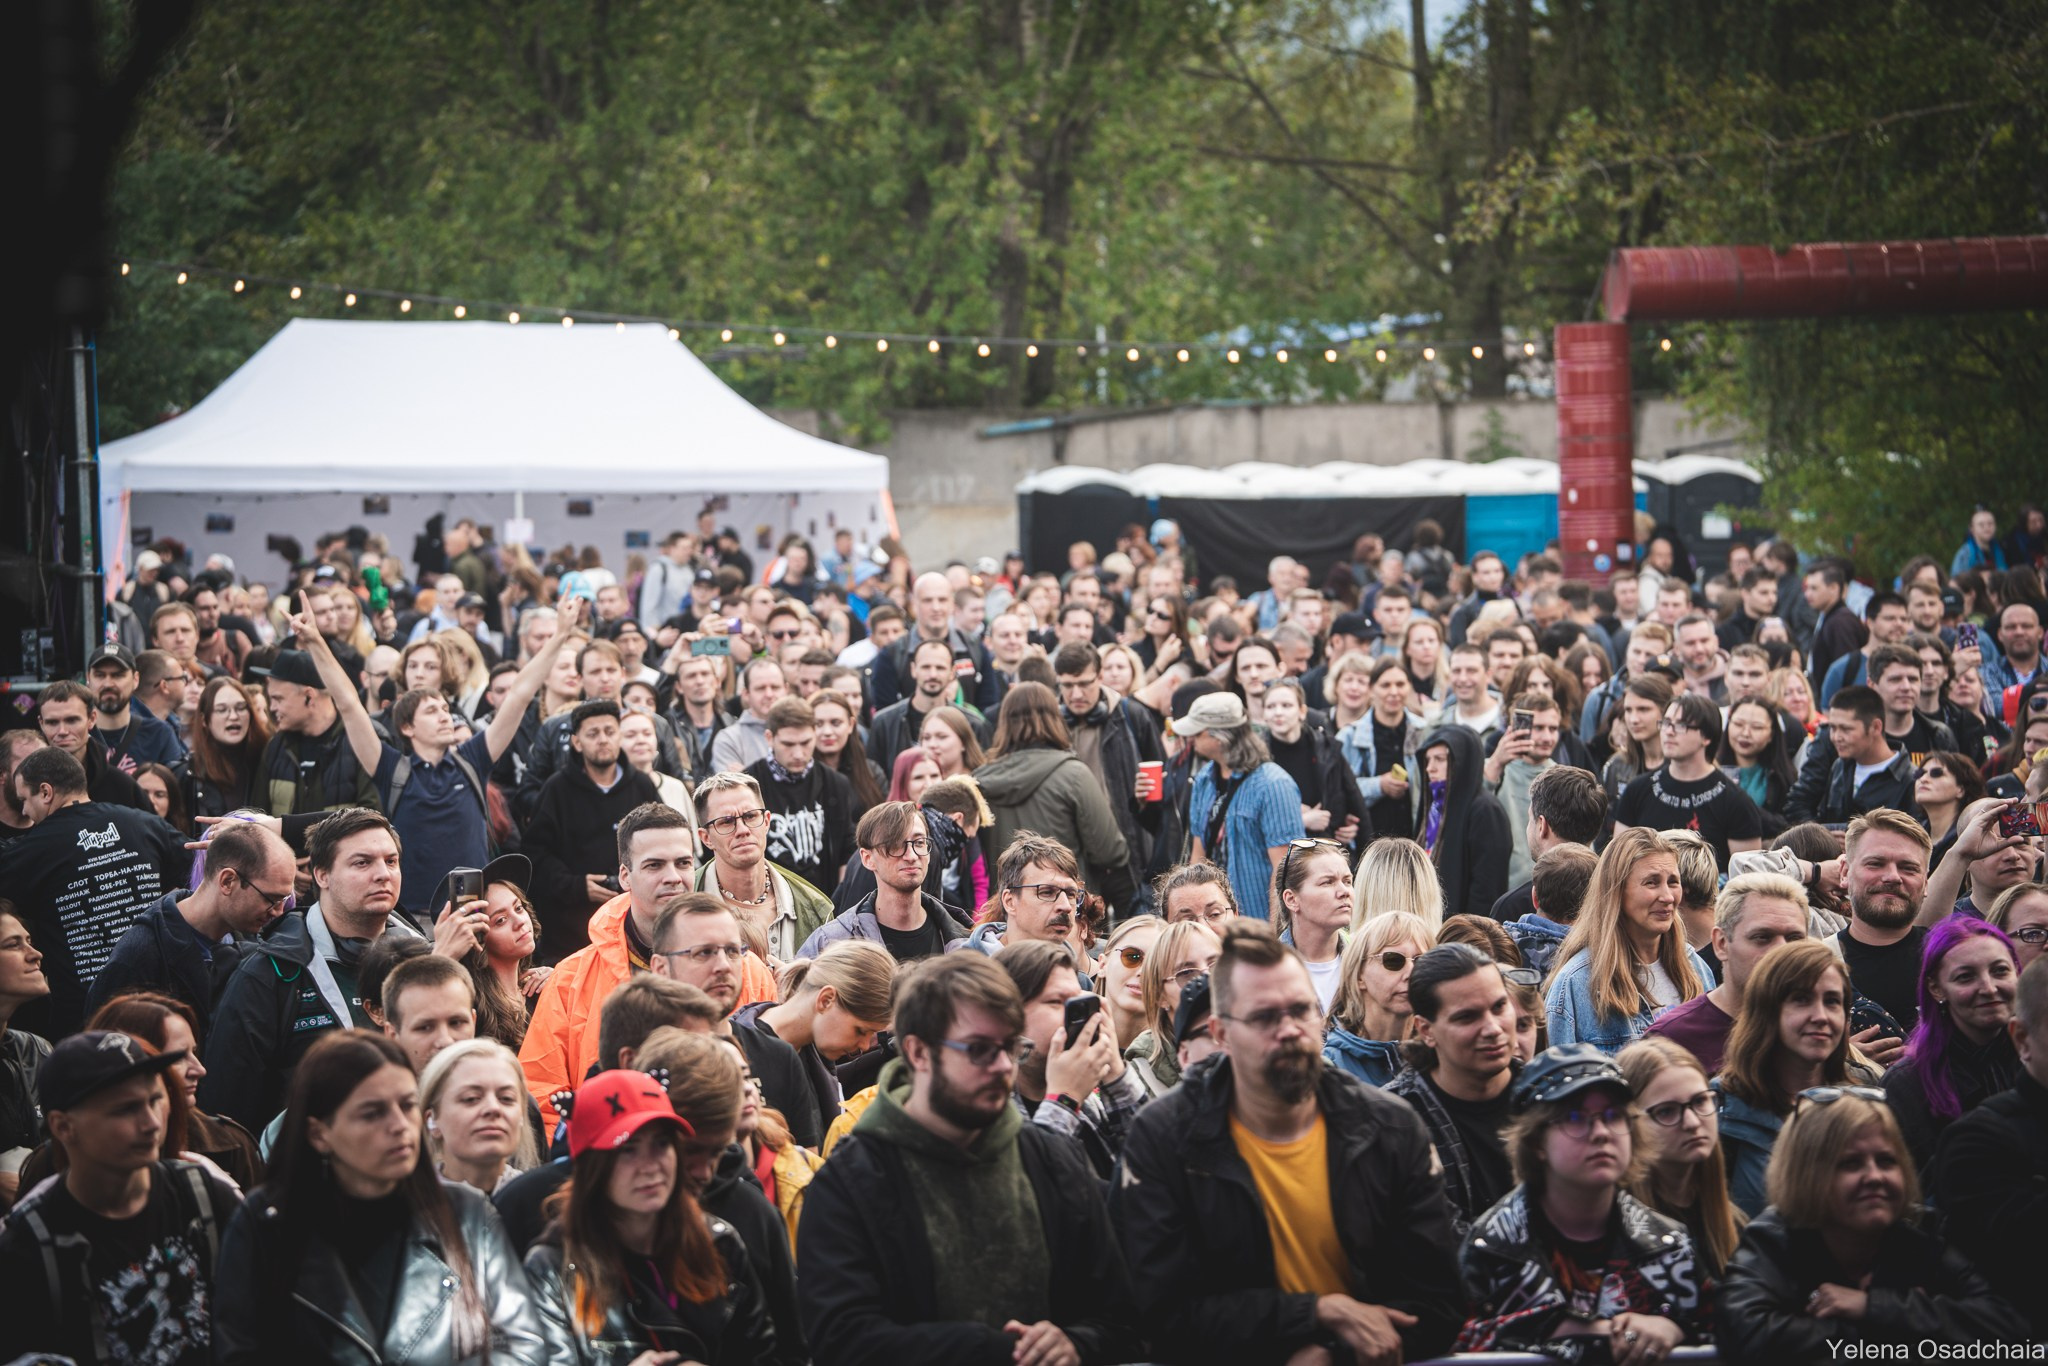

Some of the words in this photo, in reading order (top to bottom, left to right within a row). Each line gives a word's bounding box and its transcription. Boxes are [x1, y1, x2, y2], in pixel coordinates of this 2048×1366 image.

[68, 878, 88, 890] СЛОТ
[55, 888, 90, 903] АФФИНАЖ
[58, 901, 81, 912] SELLOUT
[88, 887, 132, 903] РАДИОПОМЕХИ
[93, 896, 134, 912] НАКОНЕЧНЫЙ
[89, 910, 120, 923] ВОССТАНИЯ
